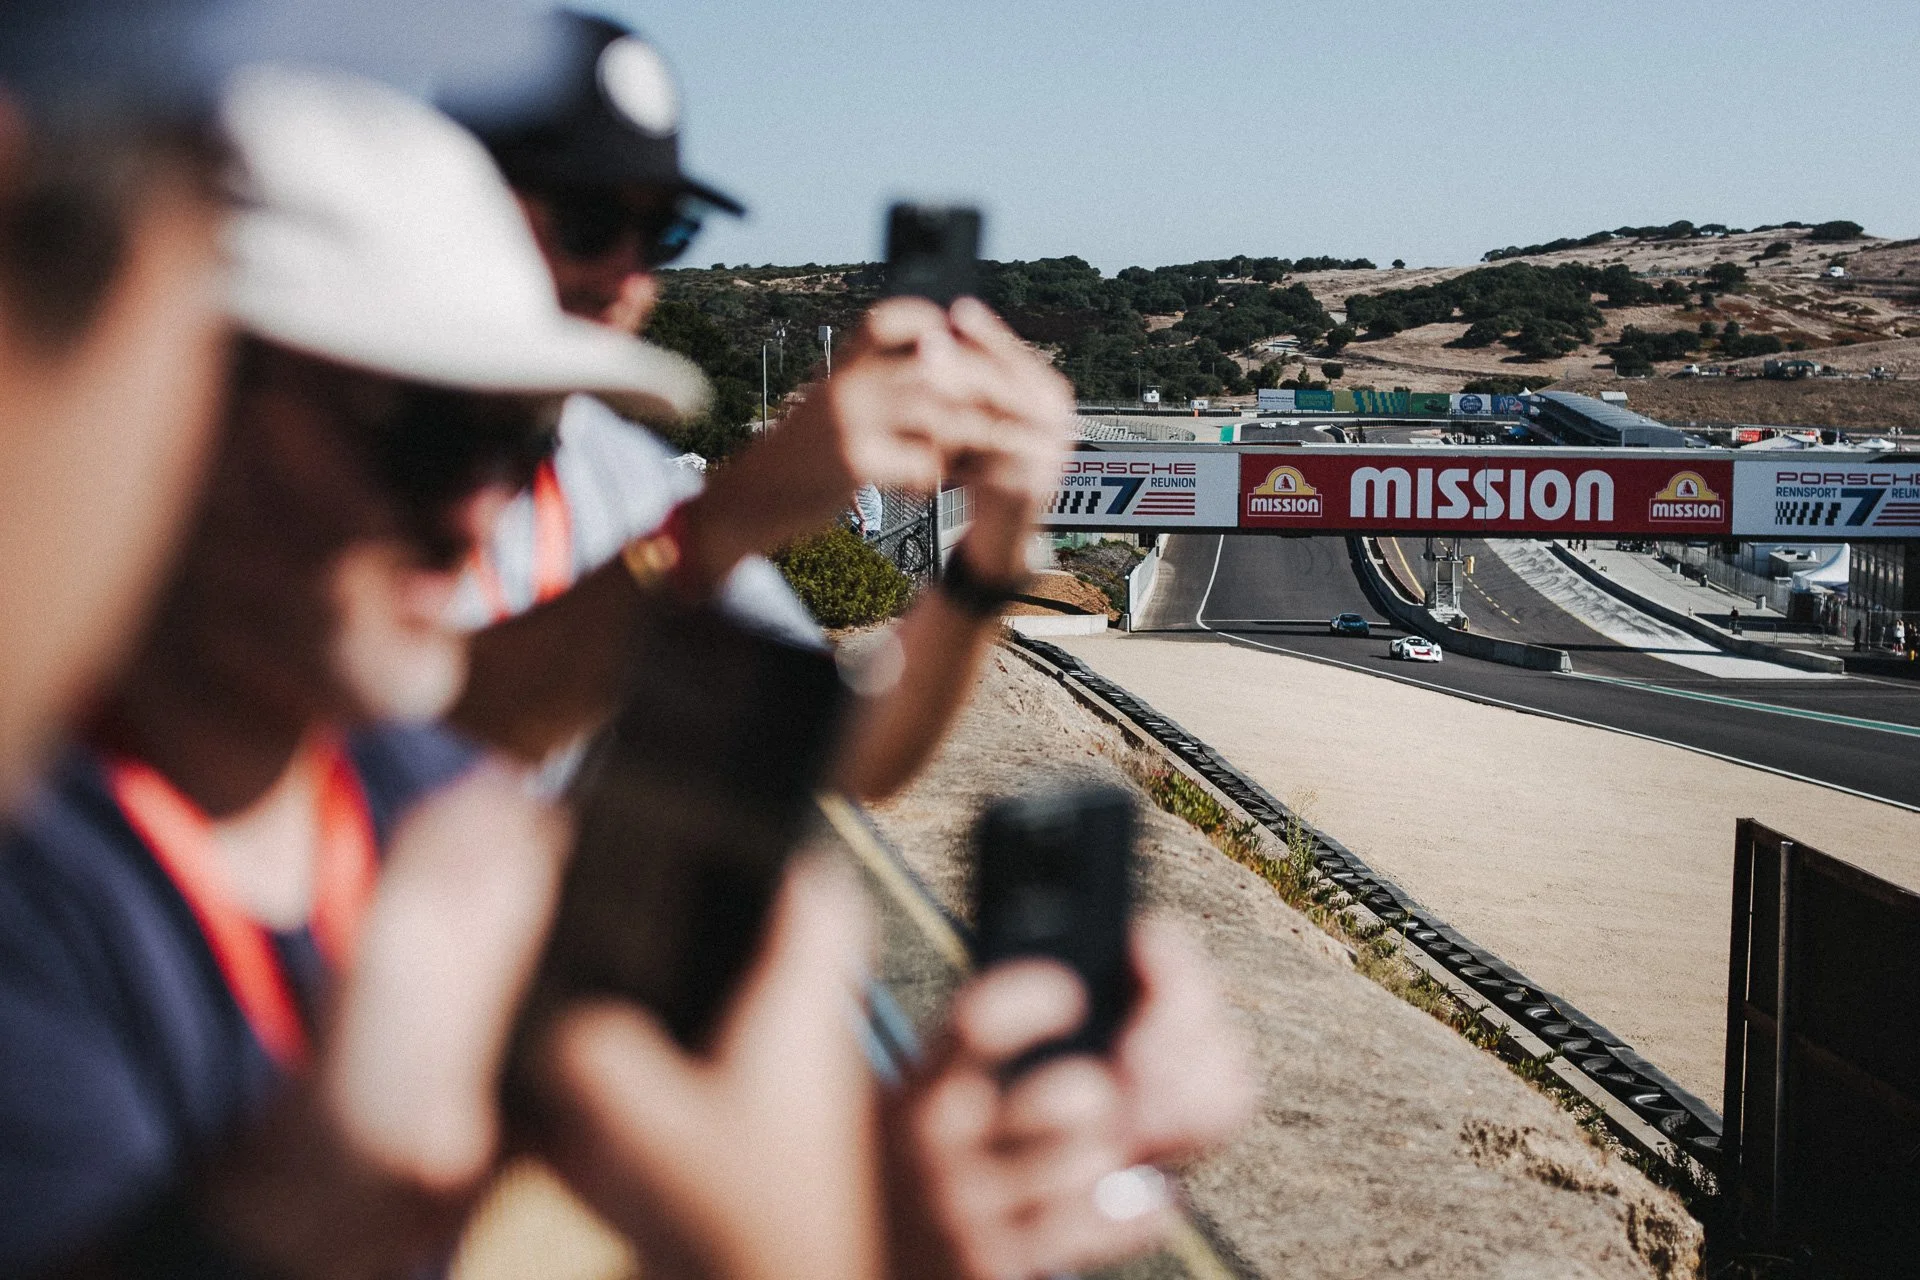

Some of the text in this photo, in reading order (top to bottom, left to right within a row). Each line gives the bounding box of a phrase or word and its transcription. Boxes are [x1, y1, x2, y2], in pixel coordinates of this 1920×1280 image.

[1061, 461, 1196, 475] ORSCHE
[1776, 472, 1920, 485] PORSCH
[1100, 476, 1146, 514] 7
[1151, 477, 1196, 488] REUNION
[1776, 487, 1920, 526] RENNSPORT 7 REUN
